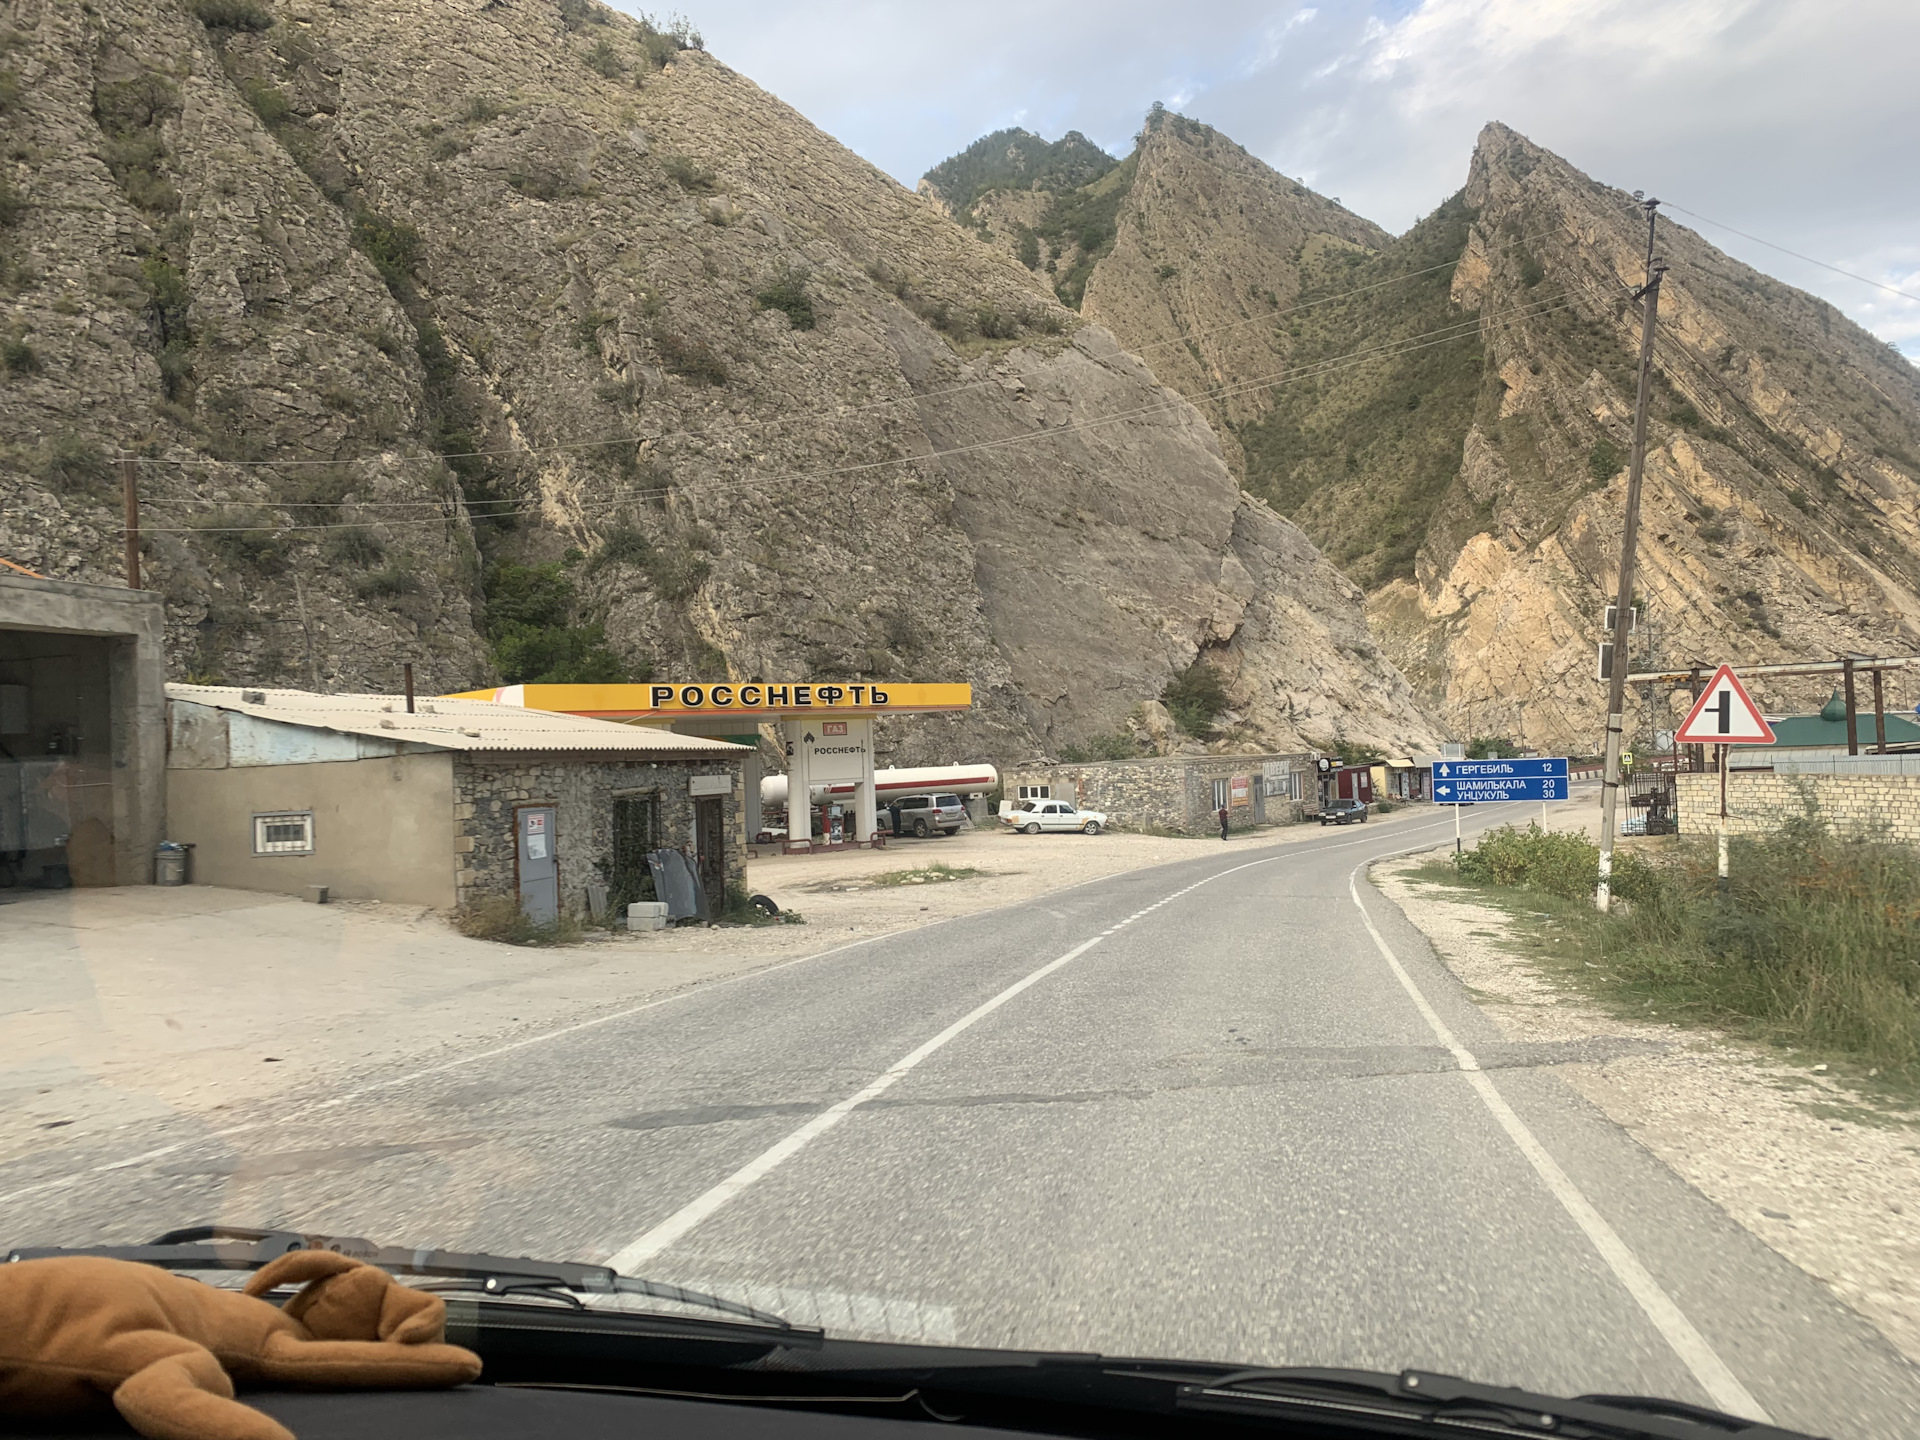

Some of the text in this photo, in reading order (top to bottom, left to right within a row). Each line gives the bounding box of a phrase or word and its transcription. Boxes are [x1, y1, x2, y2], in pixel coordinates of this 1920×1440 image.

[649, 685, 889, 708] РОССНЕФТЬ
[827, 725, 844, 733] ГАЗ
[814, 746, 866, 755] РОССНЕФТЬ
[1456, 763, 1552, 774] ГЕРГЕБИЛЬ 12
[1456, 780, 1555, 790] ШАМИЛЬКАЛА 20
[1457, 789, 1555, 800] УНЦУКУЛЬ 30
